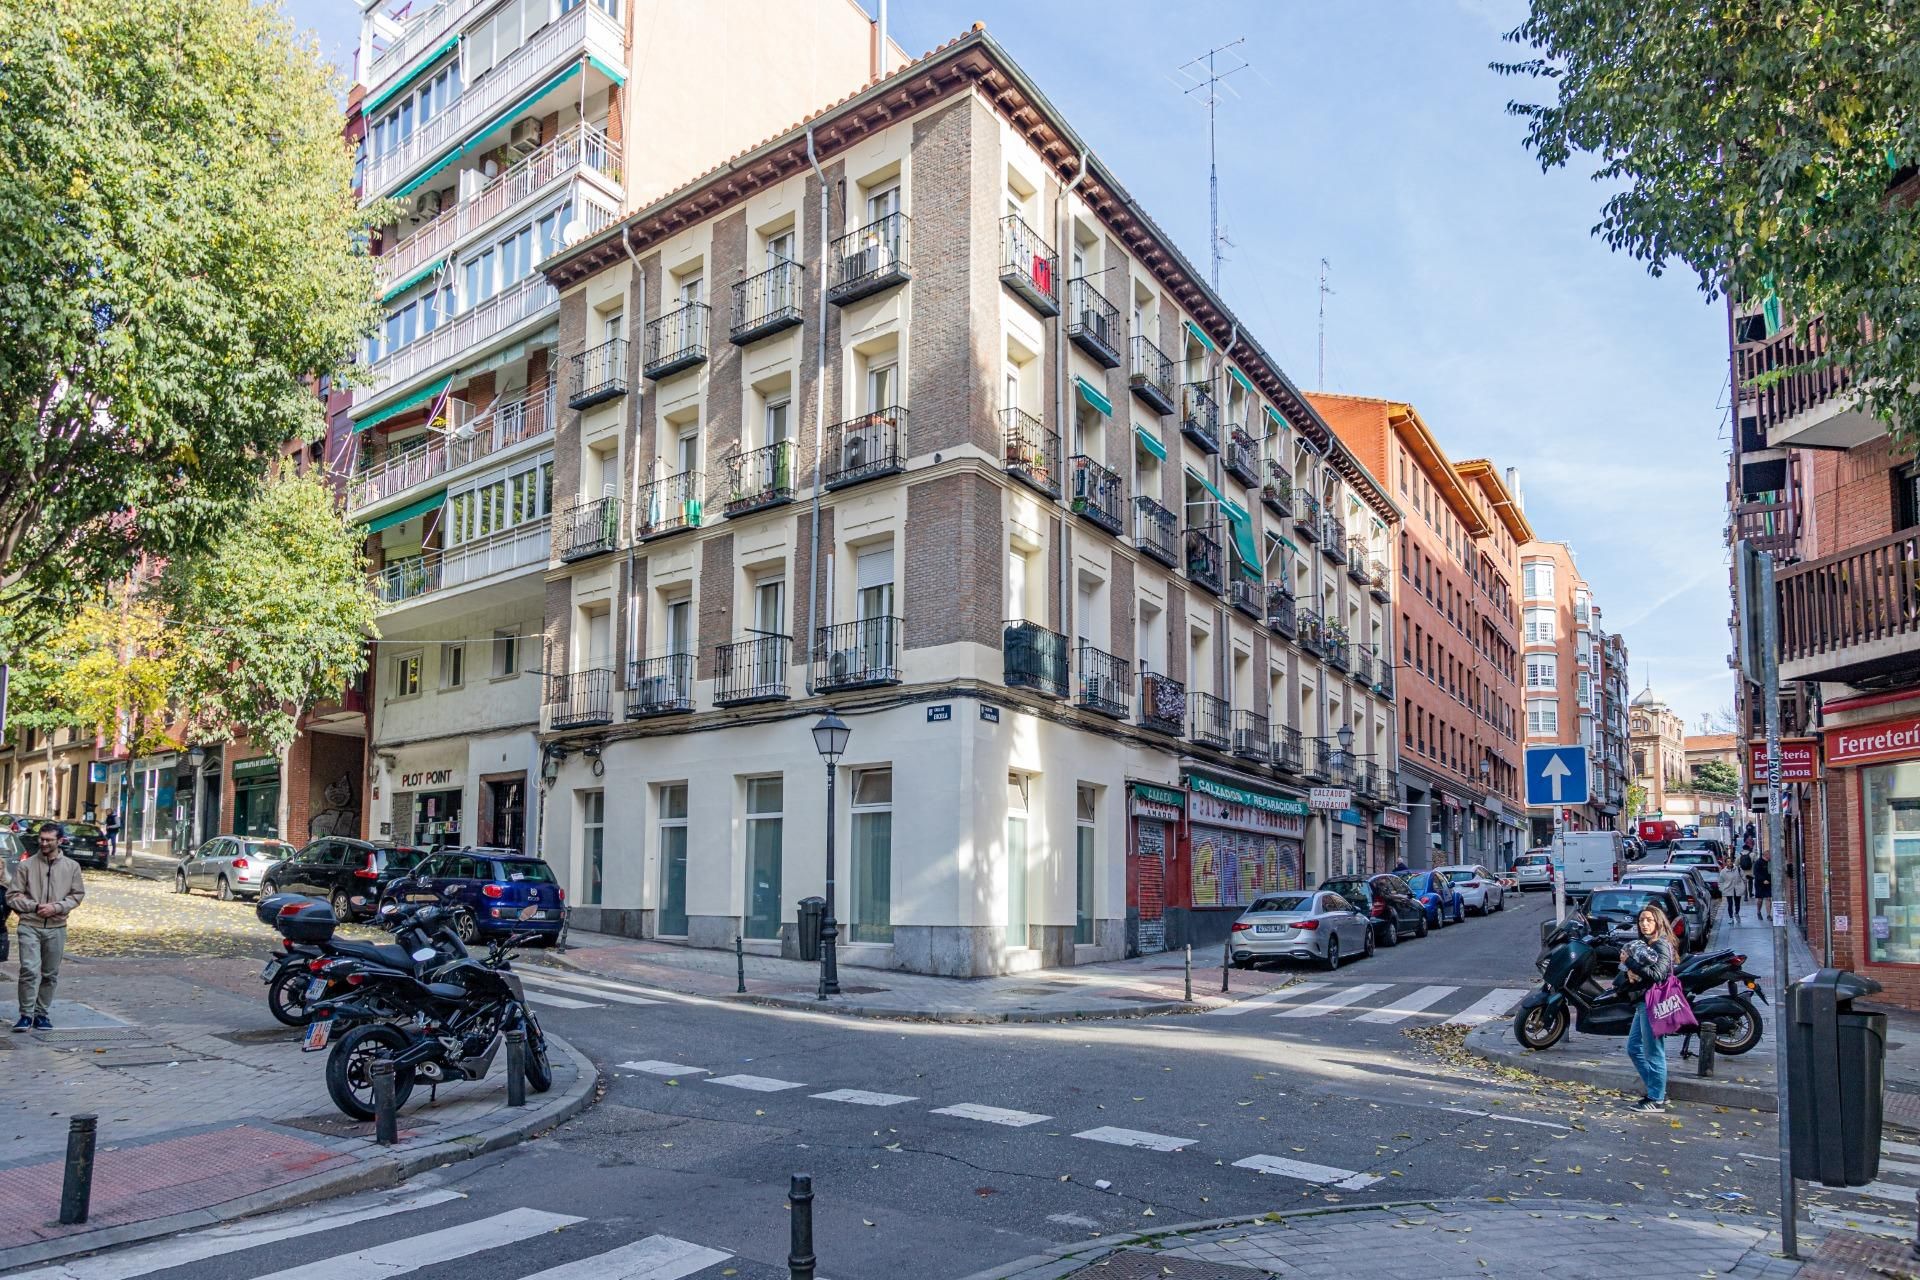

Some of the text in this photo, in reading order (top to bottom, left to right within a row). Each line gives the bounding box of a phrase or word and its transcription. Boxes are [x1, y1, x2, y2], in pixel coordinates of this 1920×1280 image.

[1754, 749, 1810, 761] Fetería
[402, 770, 452, 787] PLOT POINT
[1754, 769, 1811, 779] LAADOR
[1198, 779, 1303, 813] CALZADOS Y REPARACIONES
[1313, 788, 1347, 798] CALZADOS
[1147, 809, 1172, 819] AMADO
[1199, 796, 1244, 823] CALZDOS
